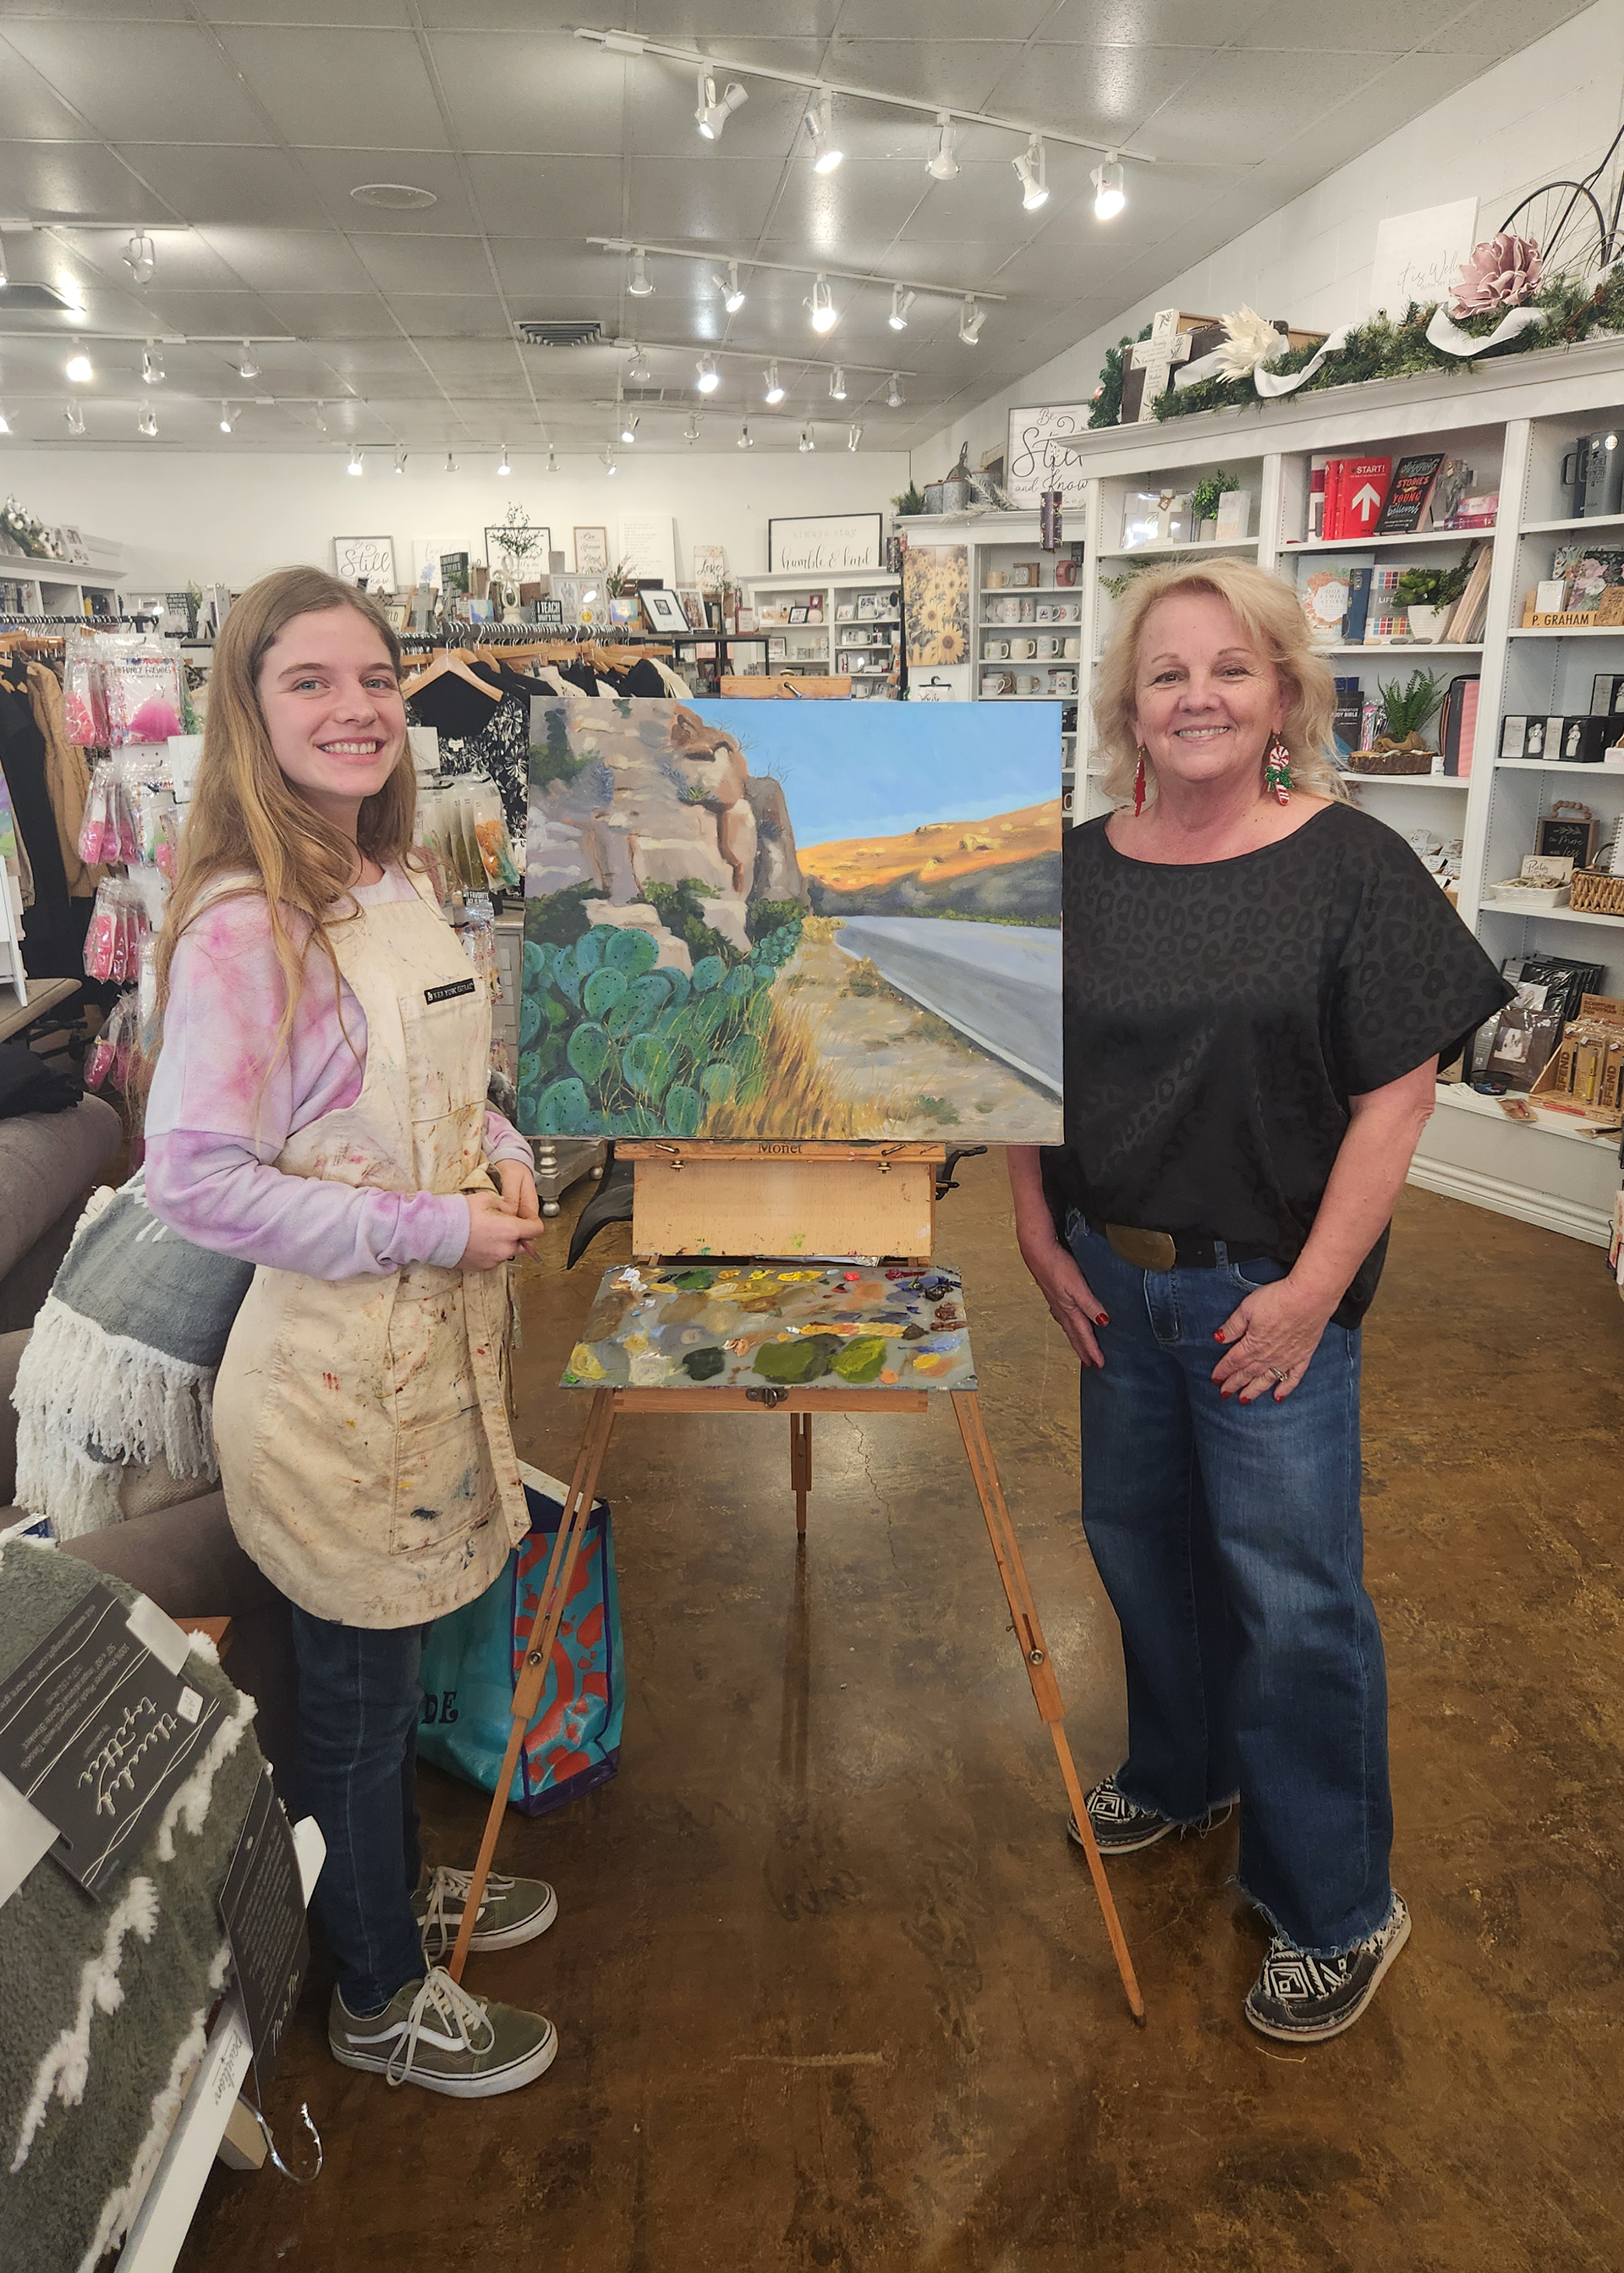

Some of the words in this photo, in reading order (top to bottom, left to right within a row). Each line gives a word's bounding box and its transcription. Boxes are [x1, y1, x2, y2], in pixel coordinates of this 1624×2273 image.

[1429, 250, 1459, 283] Well
[1037, 407, 1057, 426] Be
[1012, 421, 1083, 477] Stil
[1016, 477, 1039, 491] and
[1042, 469, 1089, 491] Know
[1357, 464, 1385, 474] START!
[1396, 475, 1430, 488] STORIES
[1392, 490, 1423, 504] YOUNG
[793, 530, 831, 539] always
[834, 528, 857, 537] stay
[340, 544, 391, 577] Still
[782, 544, 826, 571] humble
[828, 550, 840, 568] &
[843, 546, 872, 567] kind
[540, 601, 560, 614] TEACH
[1532, 615, 1540, 626] P.
[1544, 613, 1589, 626] GRAHAM
[1557, 1051, 1570, 1091] EFEND
[1602, 1065, 1616, 1106] EFEND
[757, 1143, 803, 1154] Monet
[92, 1657, 119, 1686] Polyester
[62, 1666, 97, 1705] Inspirational
[79, 1683, 98, 1703] Plush
[43, 1702, 66, 1726] Quote
[53, 1699, 85, 1732] Jacquard
[21, 1722, 48, 1750] Blanket
[77, 1695, 157, 1790] together
[96, 1712, 178, 1817] threaded
[214, 2029, 243, 2100] pavilion
